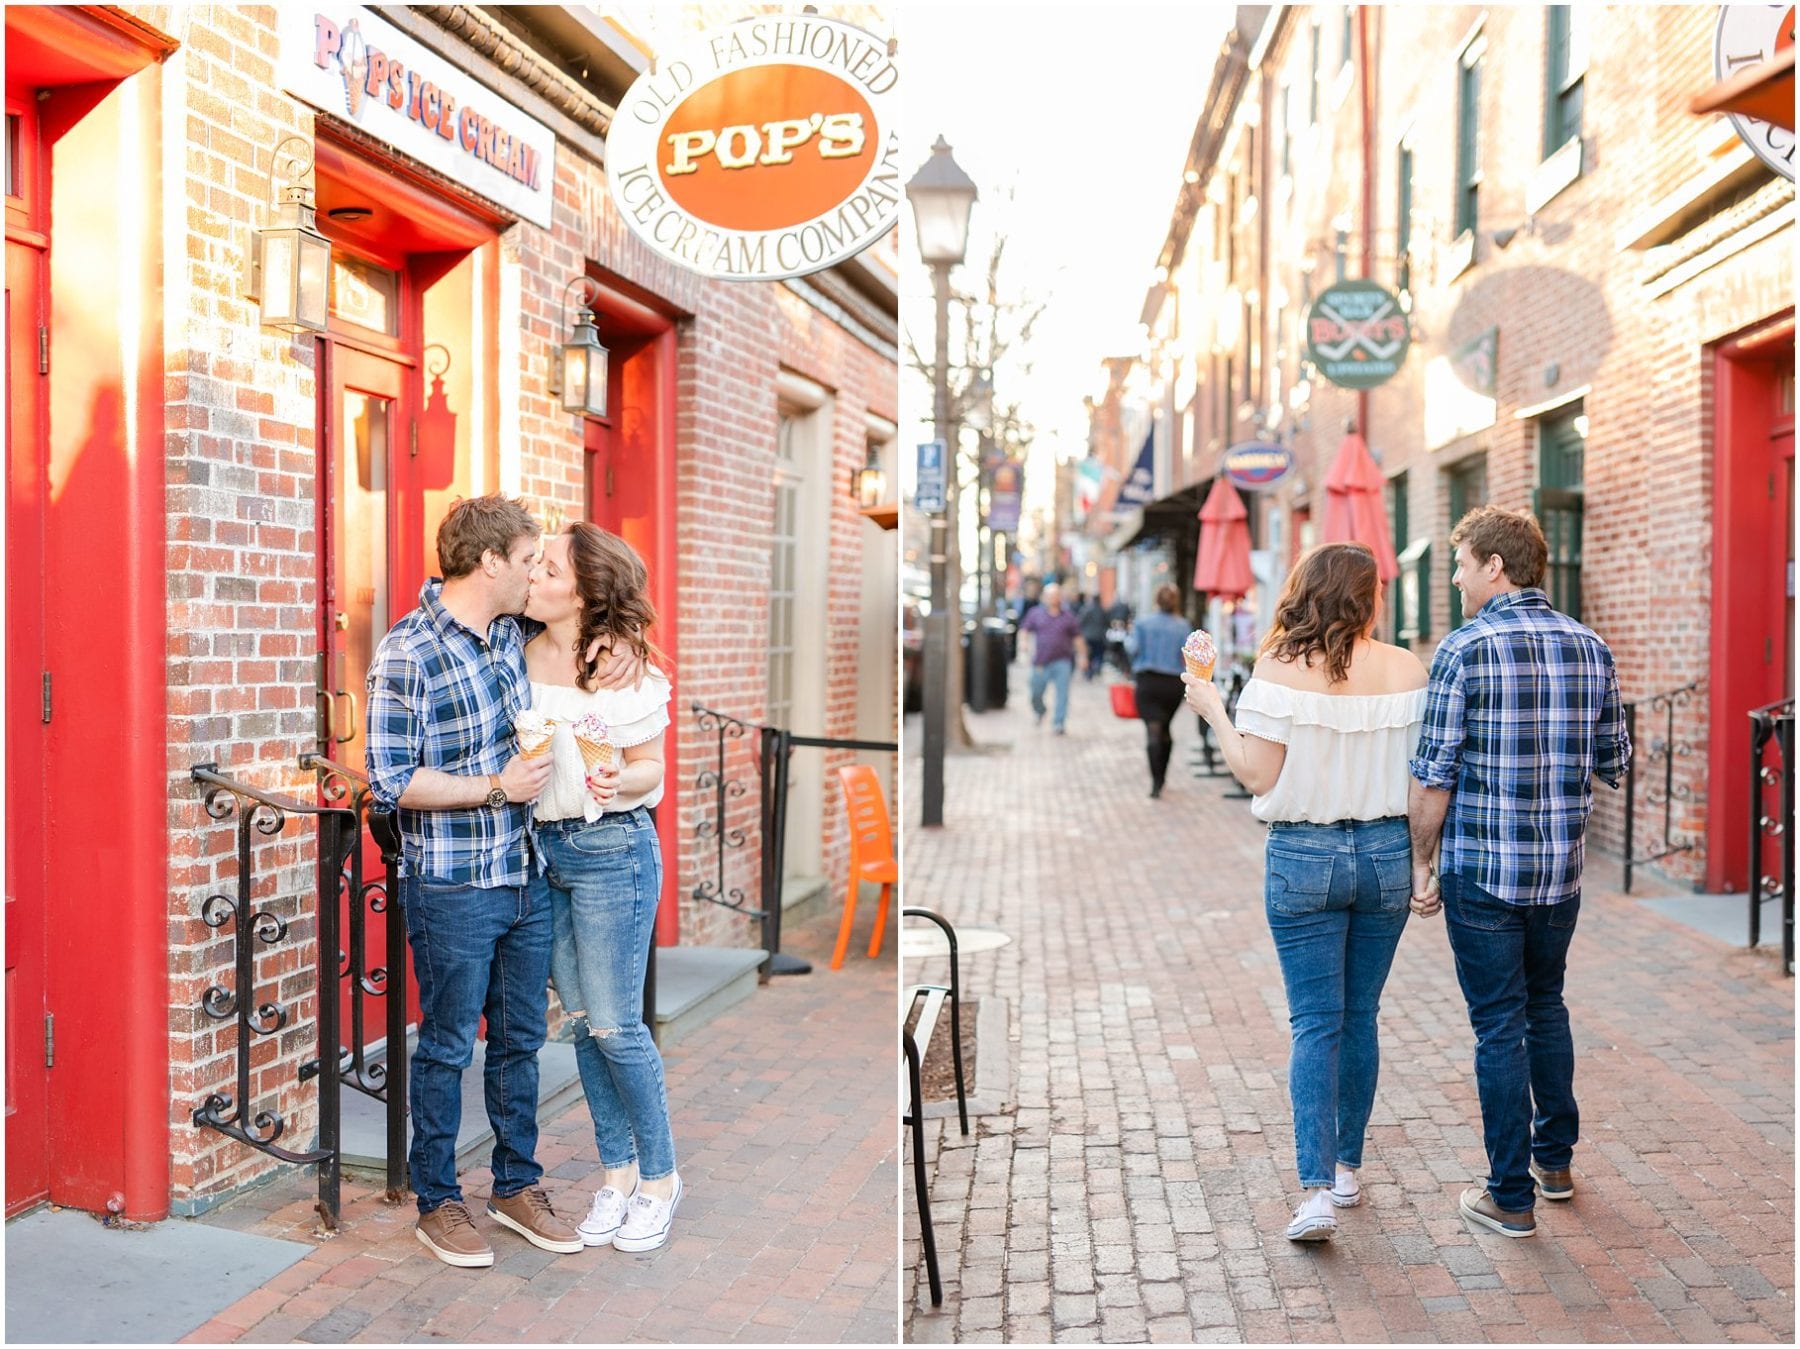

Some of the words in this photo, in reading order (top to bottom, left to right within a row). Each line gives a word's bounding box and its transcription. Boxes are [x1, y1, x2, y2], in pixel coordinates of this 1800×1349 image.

[632, 61, 694, 124] OLD
[710, 22, 898, 95] FASHIONED
[406, 70, 455, 140] ICE
[458, 106, 541, 192] CREAM
[665, 113, 866, 176] POP'S
[618, 163, 665, 225] ICE
